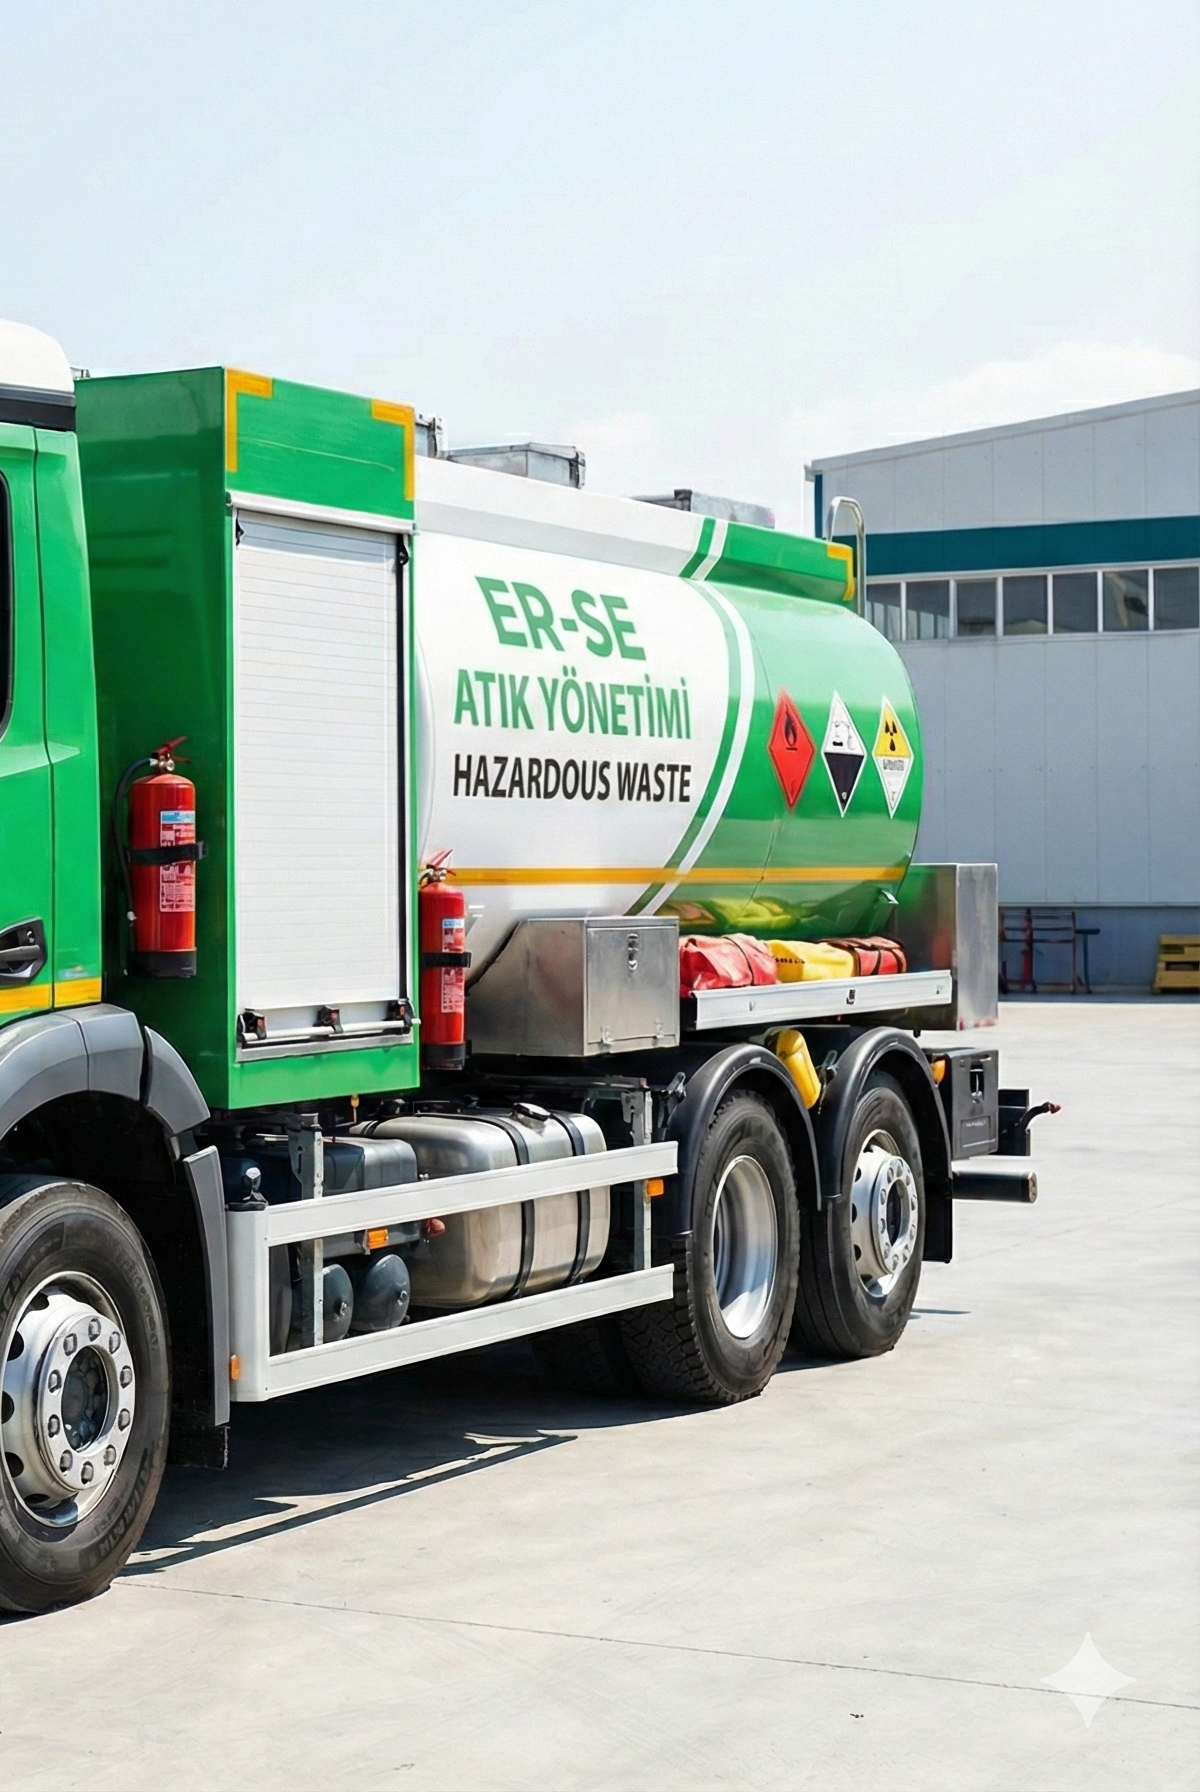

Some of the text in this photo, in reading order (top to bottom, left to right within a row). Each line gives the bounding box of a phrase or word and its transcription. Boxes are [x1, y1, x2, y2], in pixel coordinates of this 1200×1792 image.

[474, 574, 647, 661] ER-SE
[453, 665, 692, 739] ATIK YÖNETİMİ
[453, 753, 692, 803] HAZARDOUS WASTE
